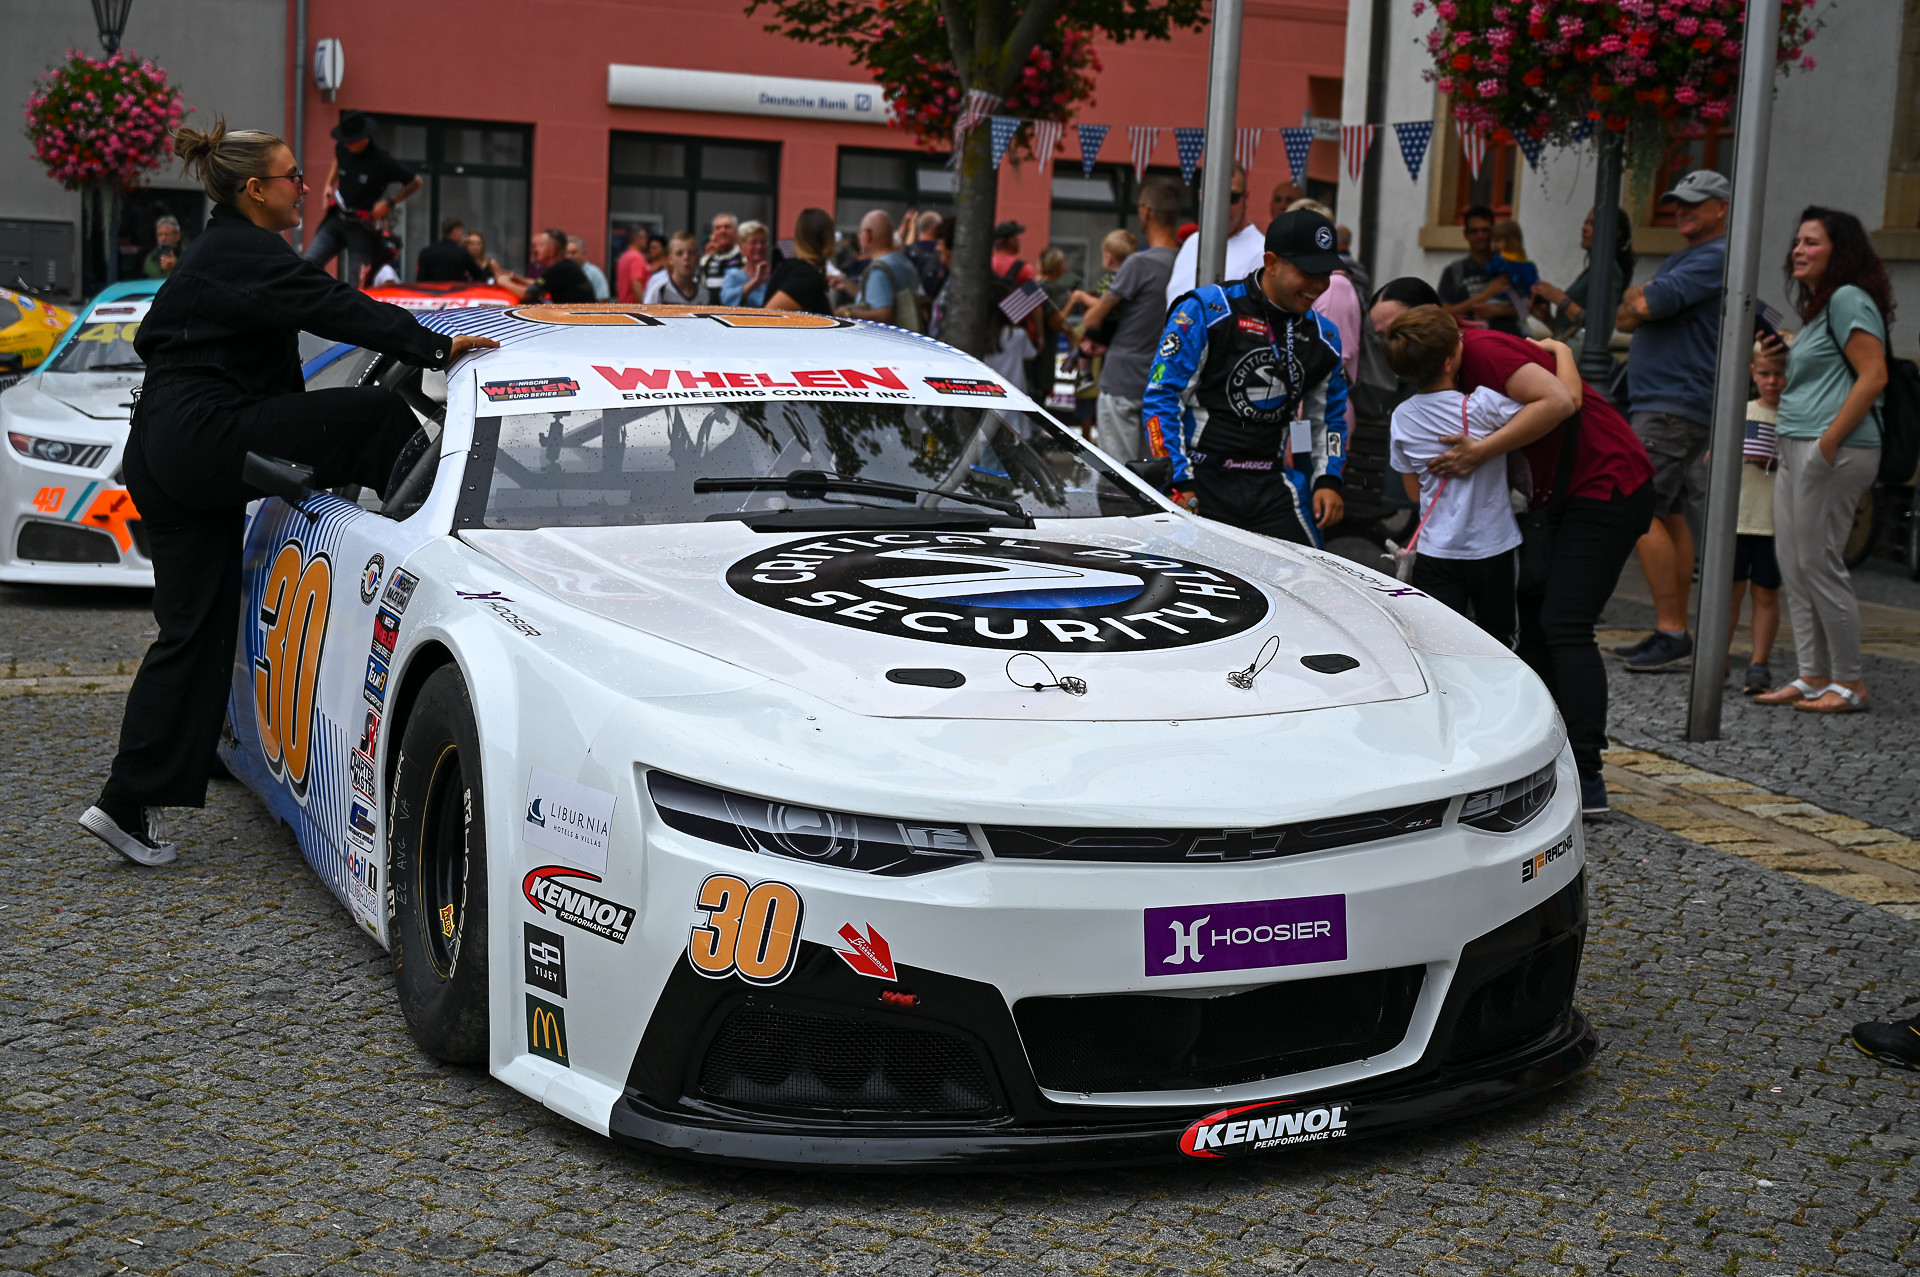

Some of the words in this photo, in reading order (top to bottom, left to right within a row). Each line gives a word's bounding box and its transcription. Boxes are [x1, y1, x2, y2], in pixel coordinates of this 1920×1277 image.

[759, 92, 814, 108] Deutsche
[818, 97, 848, 110] Bank
[482, 381, 580, 396] WHELEN
[591, 365, 909, 391] WHELEN
[622, 388, 766, 401] ENGINEERING
[772, 389, 874, 399] COMPANY
[877, 391, 917, 400] INC.
[32, 486, 67, 513] 40
[752, 534, 1041, 584] CRITICAL
[1073, 550, 1241, 600] PATH
[785, 590, 1229, 643] SECURITY
[374, 616, 399, 654] WHELEN
[253, 537, 333, 807] 30
[551, 803, 608, 837] LIBURNIA
[553, 825, 573, 838] HOTELS
[581, 835, 602, 848] VILLAS
[1545, 834, 1573, 864] RACING
[343, 840, 367, 884] Mobil
[529, 876, 629, 932] KENNOL
[442, 909, 452, 933] AERO
[560, 911, 611, 936] PERFORMANCE
[612, 931, 626, 941] OIL
[688, 871, 807, 987] 30
[1211, 920, 1331, 947] HOOSIER
[534, 965, 558, 983] TIJEY
[1193, 1106, 1348, 1151] KENNOL
[1254, 1131, 1330, 1150] PERFORMANCE
[1332, 1129, 1348, 1139] OIL
